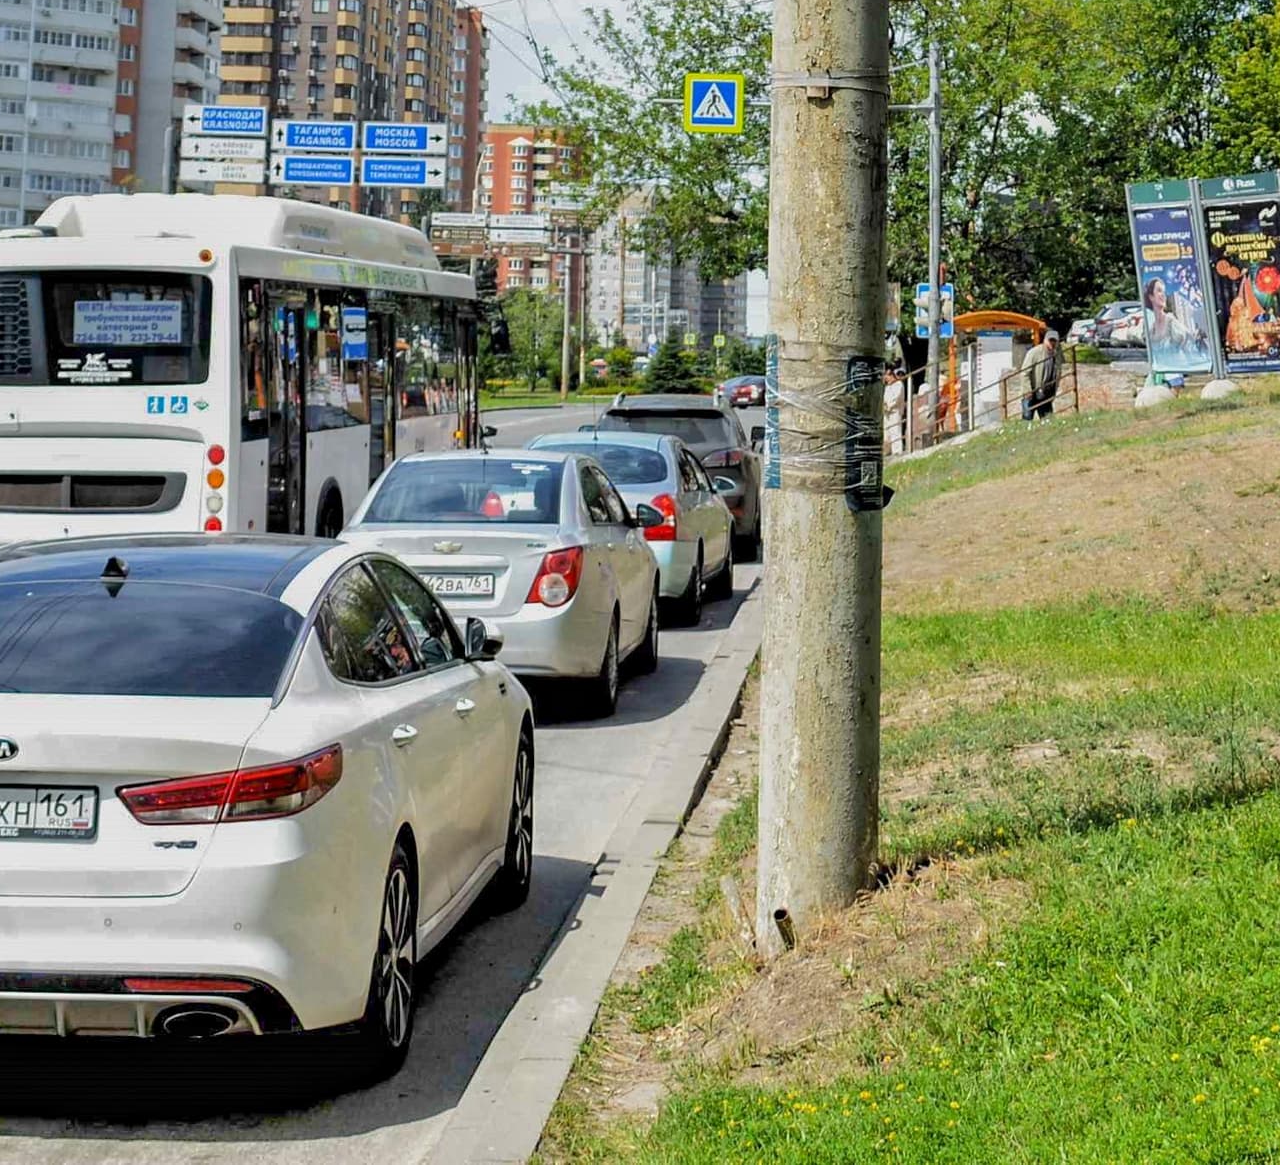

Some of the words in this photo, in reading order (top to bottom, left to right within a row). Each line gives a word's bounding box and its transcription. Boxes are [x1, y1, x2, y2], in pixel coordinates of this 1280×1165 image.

[203, 109, 262, 120] КРАСНОДАР
[203, 120, 261, 131] KRASNODAR
[294, 125, 344, 135] ТАГАНРОГ
[375, 127, 416, 137] МОСКВА
[293, 135, 346, 147] TAGANROG
[375, 137, 418, 148] MOSCOW
[40, 793, 84, 817] 161
[48, 818, 71, 826] RUS
